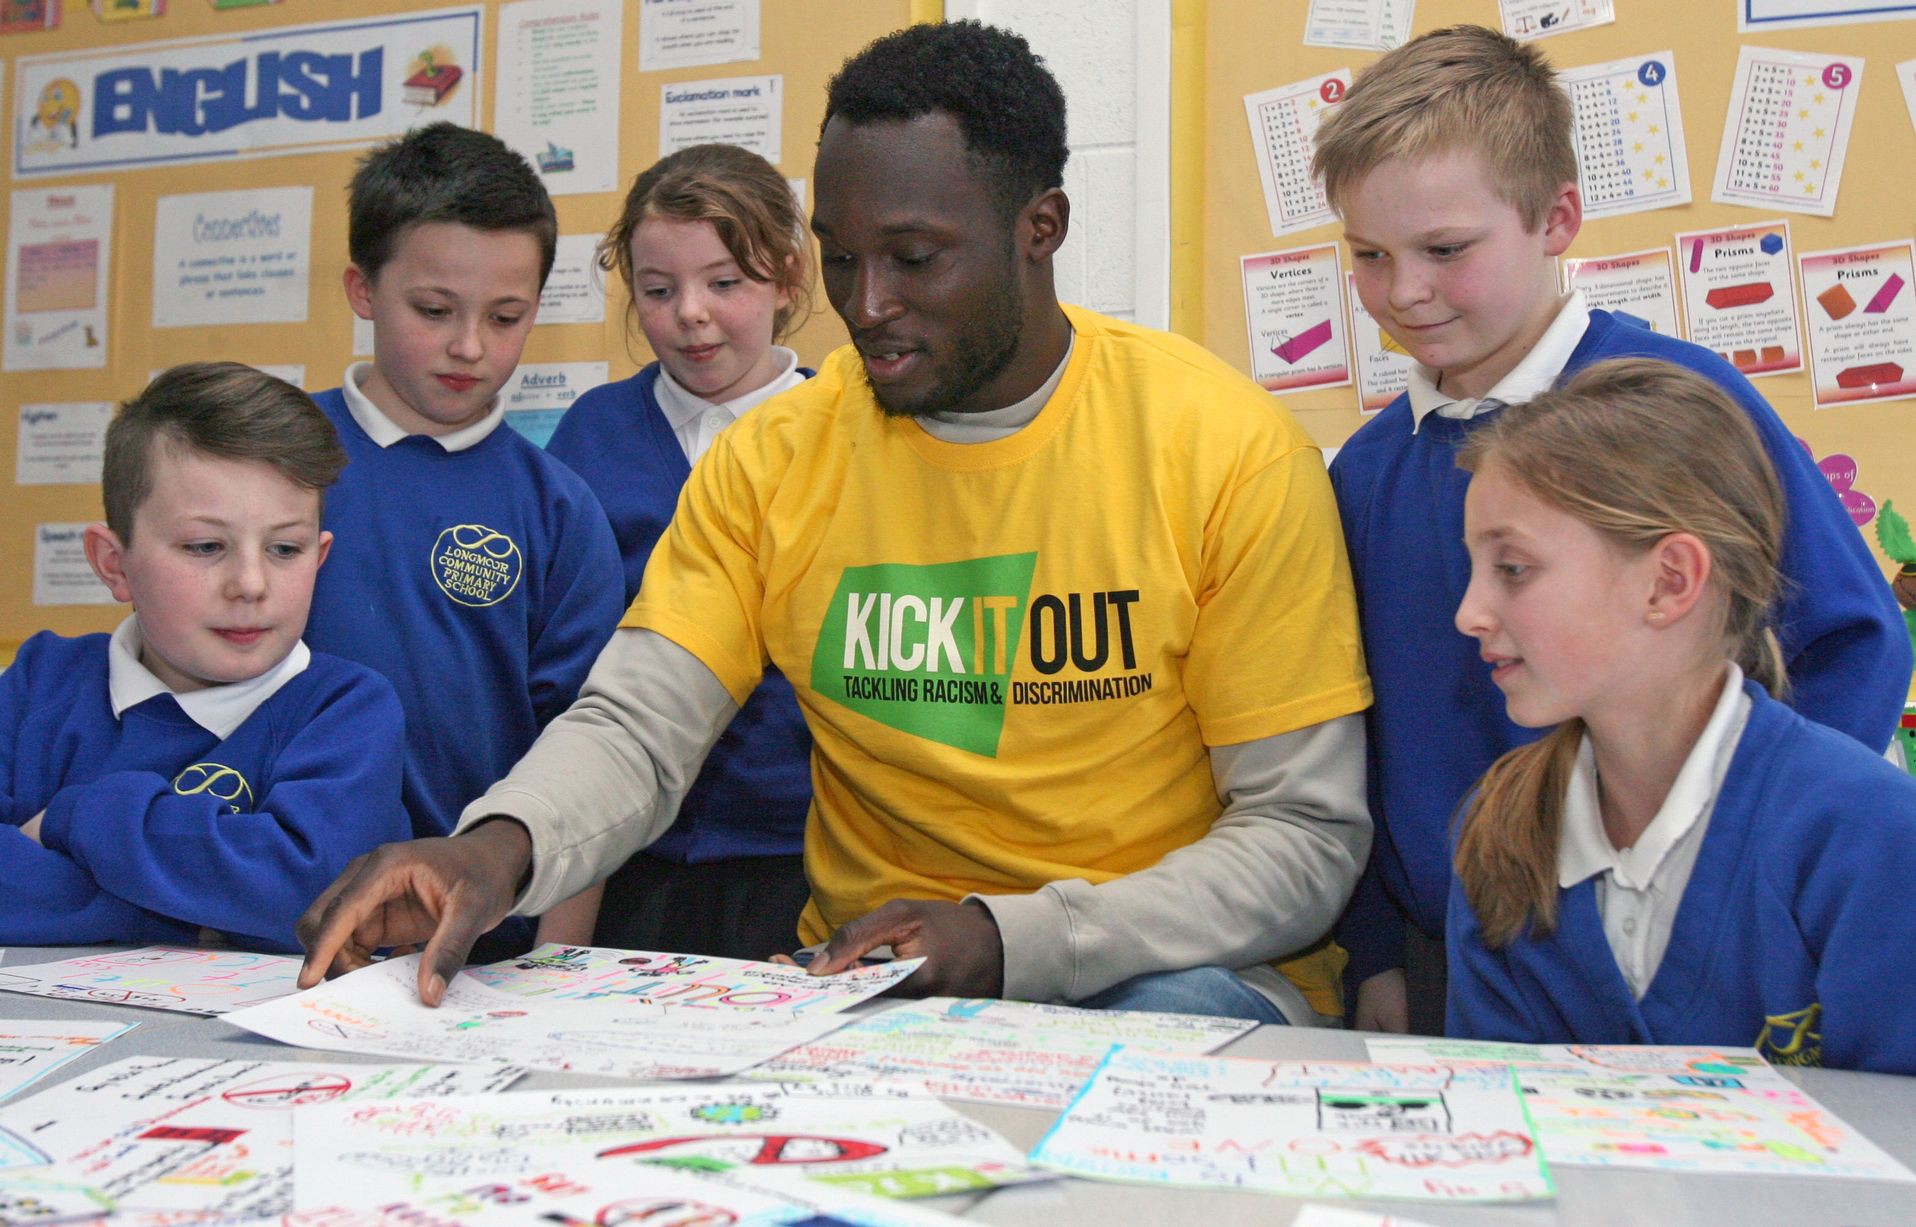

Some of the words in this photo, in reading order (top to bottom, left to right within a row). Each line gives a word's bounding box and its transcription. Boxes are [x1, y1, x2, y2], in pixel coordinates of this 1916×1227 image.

[1644, 63, 1659, 83] 4
[1830, 67, 1845, 86] 5
[92, 46, 384, 139] ENGLISH
[666, 90, 730, 104] Exclamation
[733, 87, 761, 97] mark
[1326, 82, 1338, 98] 2
[1726, 233, 1755, 241] Shapes
[1283, 254, 1309, 262] Shapes
[1715, 248, 1754, 258] Prisms
[1848, 254, 1880, 262] Shapes
[1611, 260, 1640, 269] Shapes
[1270, 268, 1312, 279] Vertices
[1837, 269, 1878, 280] Prisms
[1261, 329, 1288, 337] Vertices
[1369, 353, 1390, 363] Faces
[521, 372, 567, 386] Adverb
[444, 546, 509, 574] LONGMOOR
[438, 555, 511, 585] COMMUNITY
[444, 567, 497, 592] PRIMARY
[444, 578, 492, 601] SCHOOL
[842, 592, 966, 674] KICK
[972, 595, 1017, 675] IT
[1029, 589, 1140, 675] OUT
[843, 675, 918, 702] TACKLING
[922, 679, 988, 705] RACISM
[990, 682, 1003, 705] &
[1013, 673, 1152, 704] DISCRIMINATION
